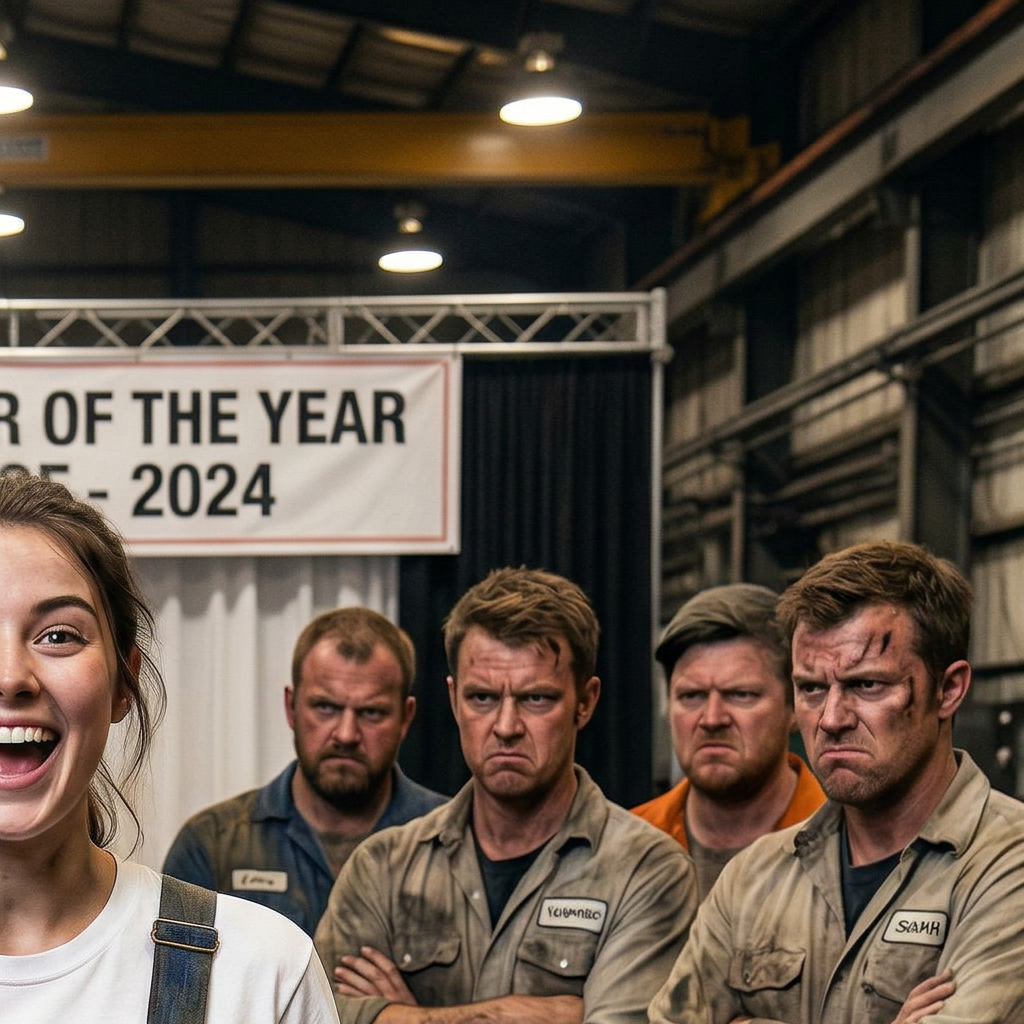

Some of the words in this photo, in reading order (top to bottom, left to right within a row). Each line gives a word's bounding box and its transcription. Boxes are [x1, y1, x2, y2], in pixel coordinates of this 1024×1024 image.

[44, 390, 113, 446] OF
[131, 390, 238, 445] THE
[258, 390, 406, 445] YEAR
[132, 463, 276, 518] 2024
